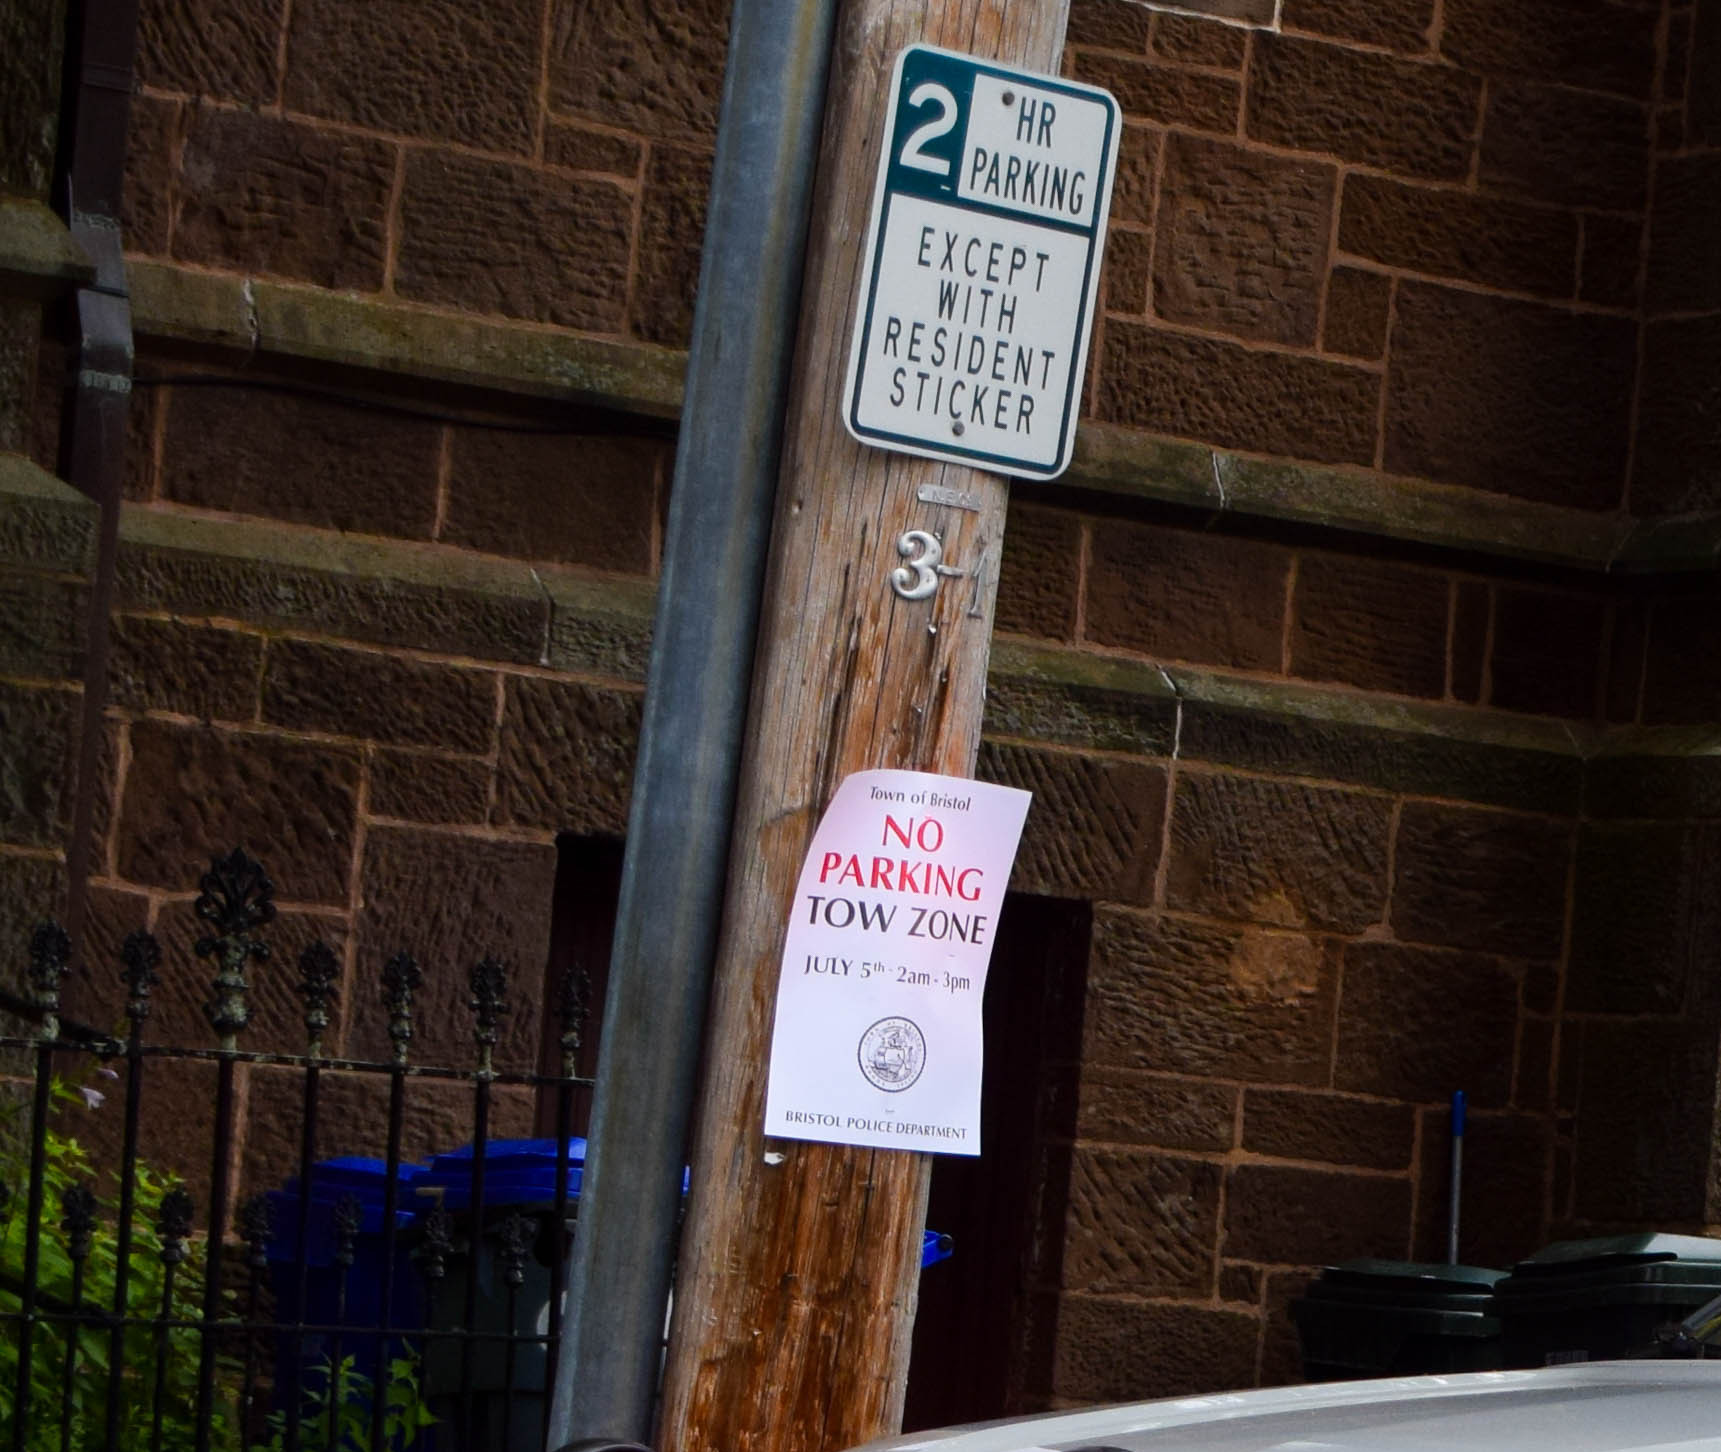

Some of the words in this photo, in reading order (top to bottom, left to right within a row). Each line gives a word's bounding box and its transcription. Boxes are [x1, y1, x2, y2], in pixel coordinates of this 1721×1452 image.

[899, 83, 959, 176] 2
[1017, 97, 1056, 148] HR
[969, 149, 1086, 215] PARKING
[918, 227, 1050, 292] EXCEPT
[938, 279, 1017, 334] WITH
[883, 317, 1056, 390] RESIDENT
[889, 368, 1035, 434] STICKER
[870, 786, 905, 803] Town
[911, 789, 927, 805] of
[930, 792, 971, 811] Bristol
[882, 813, 944, 852] NO
[818, 852, 984, 901] PARKING
[807, 895, 897, 933] TOW
[908, 907, 987, 944] ZONE
[805, 955, 853, 977] JULY
[860, 960, 885, 979] 5th
[896, 966, 930, 987] 2am
[943, 971, 970, 993] 3pm
[785, 1110, 842, 1127] BRISTOL
[847, 1117, 893, 1133] POLICE
[896, 1122, 967, 1140] DEPARTMENT
